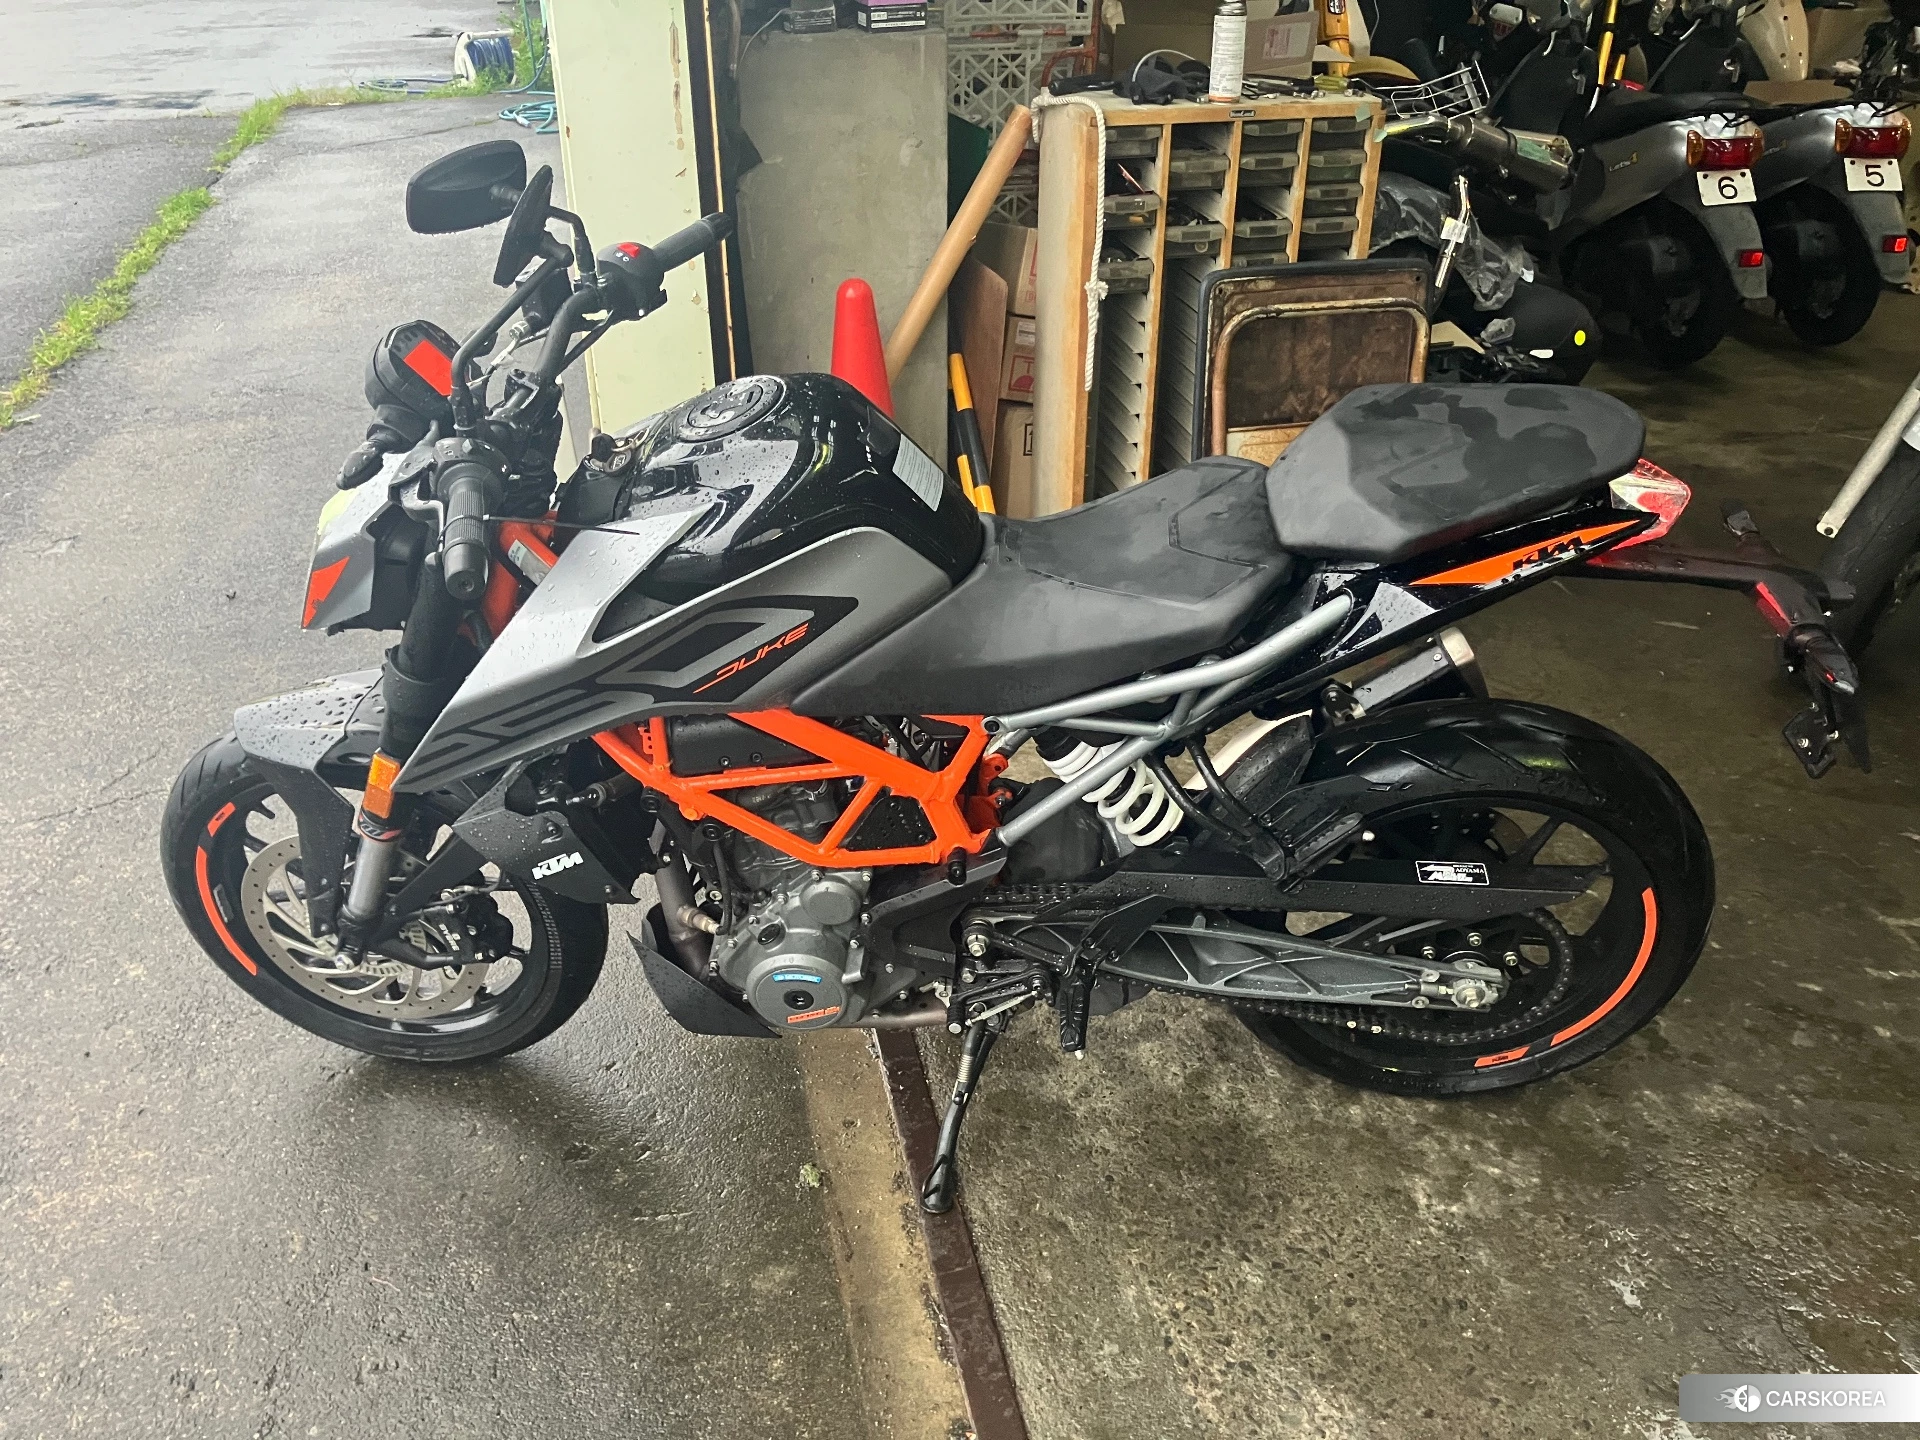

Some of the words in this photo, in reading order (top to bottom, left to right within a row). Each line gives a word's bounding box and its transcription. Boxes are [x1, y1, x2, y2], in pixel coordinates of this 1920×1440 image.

[1717, 176, 1739, 200] 6
[1864, 164, 1885, 187] 5
[1512, 536, 1583, 571] KTM
[693, 622, 809, 694] DUKE
[531, 851, 584, 880] KTM
